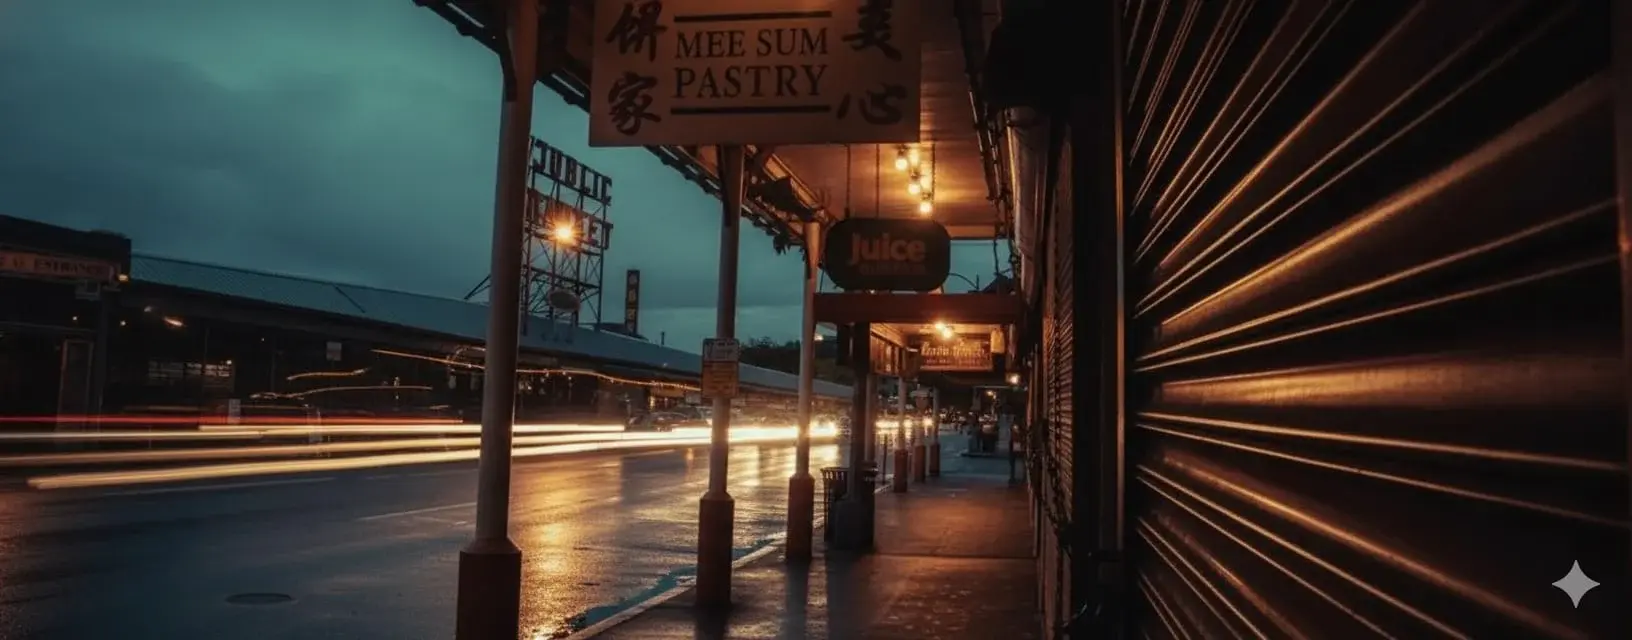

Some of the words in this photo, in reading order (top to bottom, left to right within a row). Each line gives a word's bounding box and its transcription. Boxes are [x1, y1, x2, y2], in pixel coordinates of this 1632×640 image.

[674, 29, 747, 59] MEE
[756, 26, 829, 57] SUM
[673, 63, 828, 99] PASTRY
[527, 188, 614, 250] MET
